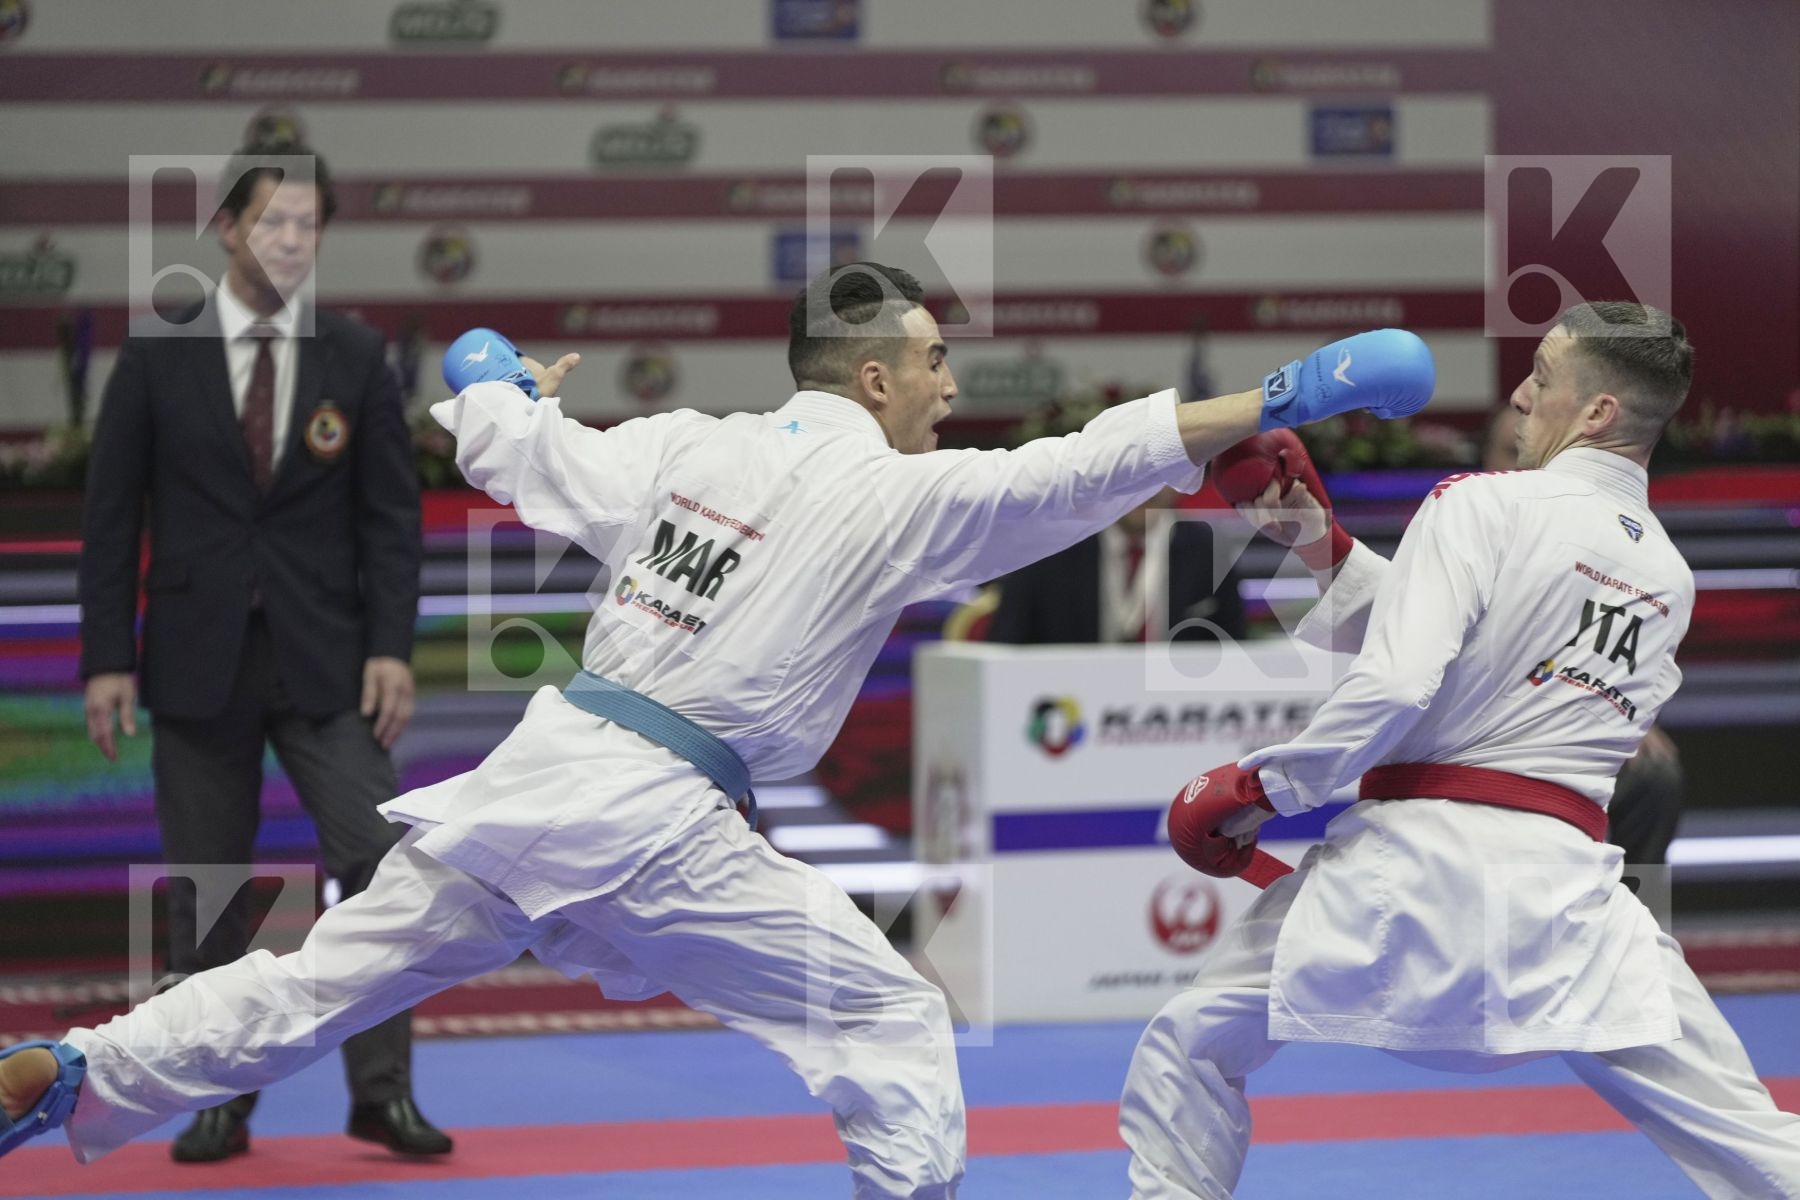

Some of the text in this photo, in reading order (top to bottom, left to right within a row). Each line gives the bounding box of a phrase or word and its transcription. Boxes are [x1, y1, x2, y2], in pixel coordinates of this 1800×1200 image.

[636, 519, 741, 601] MAR
[1575, 561, 1600, 582] WORLD
[1600, 574, 1633, 595] KARATE
[1566, 599, 1644, 675] ITA
